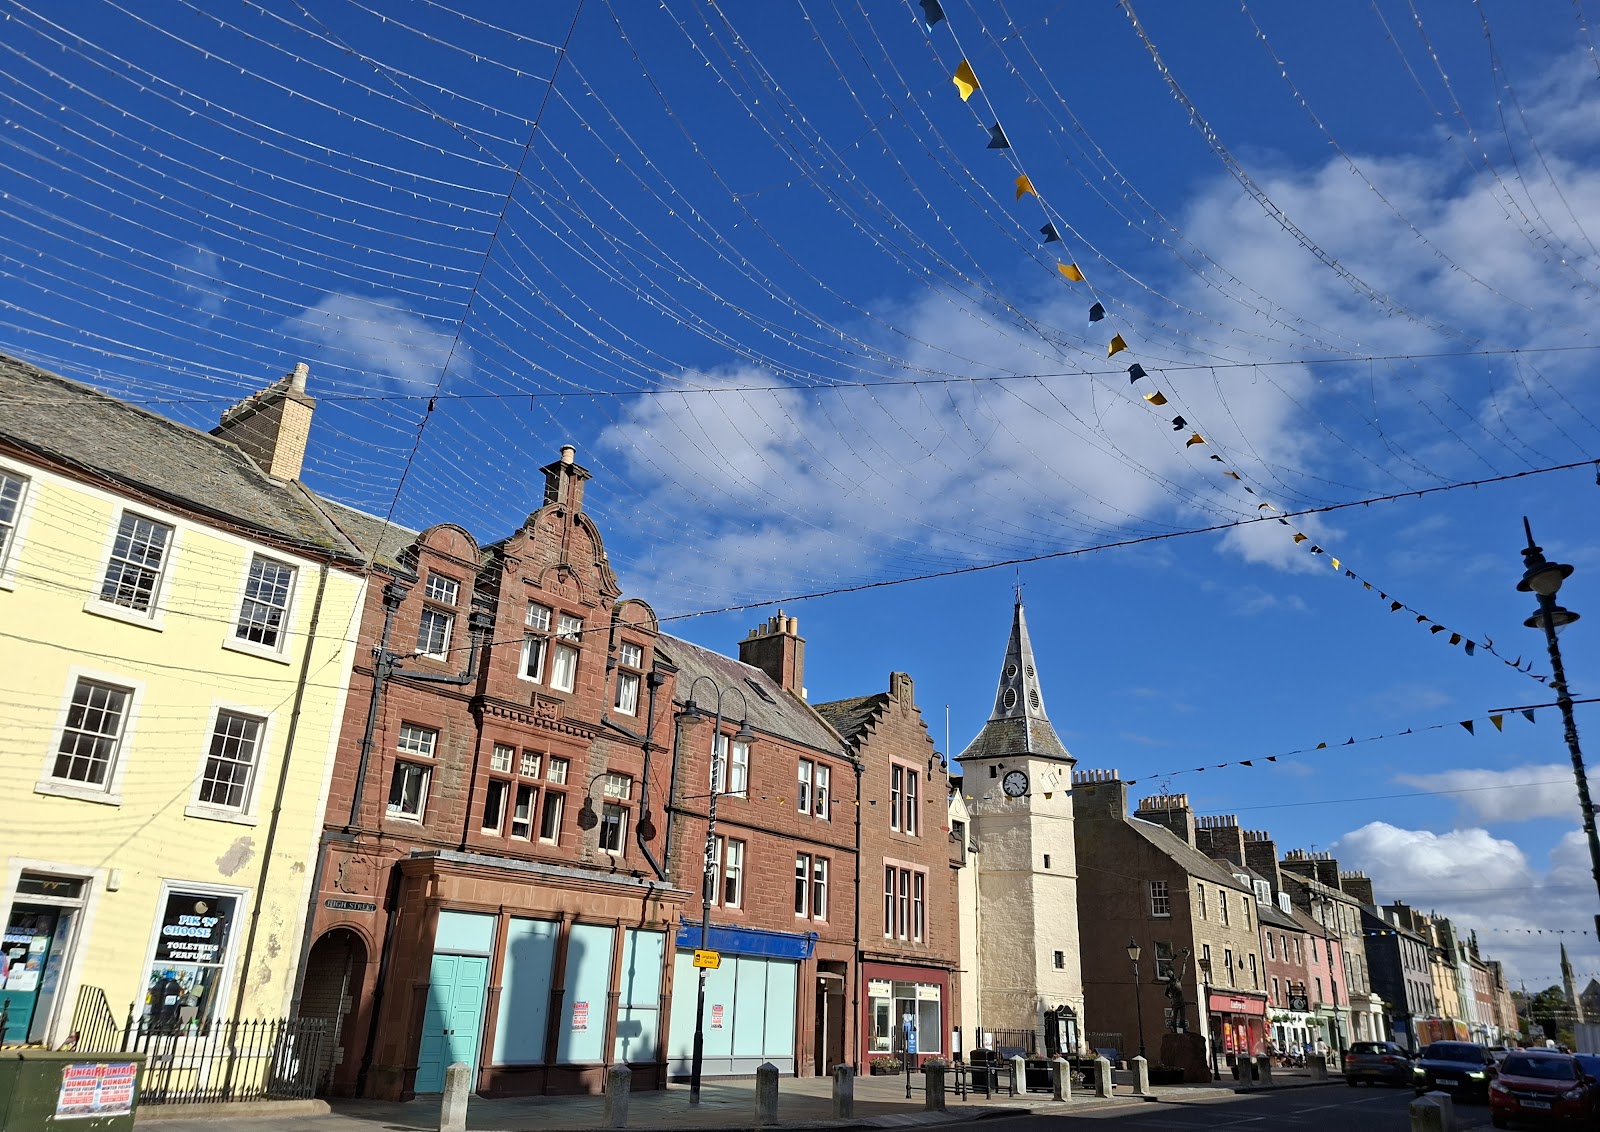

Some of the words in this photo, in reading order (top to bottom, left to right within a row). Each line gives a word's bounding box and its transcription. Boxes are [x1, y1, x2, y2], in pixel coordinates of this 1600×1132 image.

[349, 903, 374, 911] STREET
[178, 915, 200, 926] PIK
[163, 925, 212, 938] CHOOSE
[167, 942, 219, 951] TOILETRIES
[170, 951, 212, 960] PERFUME
[65, 1067, 101, 1078] FUNFAIR
[101, 1065, 136, 1078] FUNFAIR
